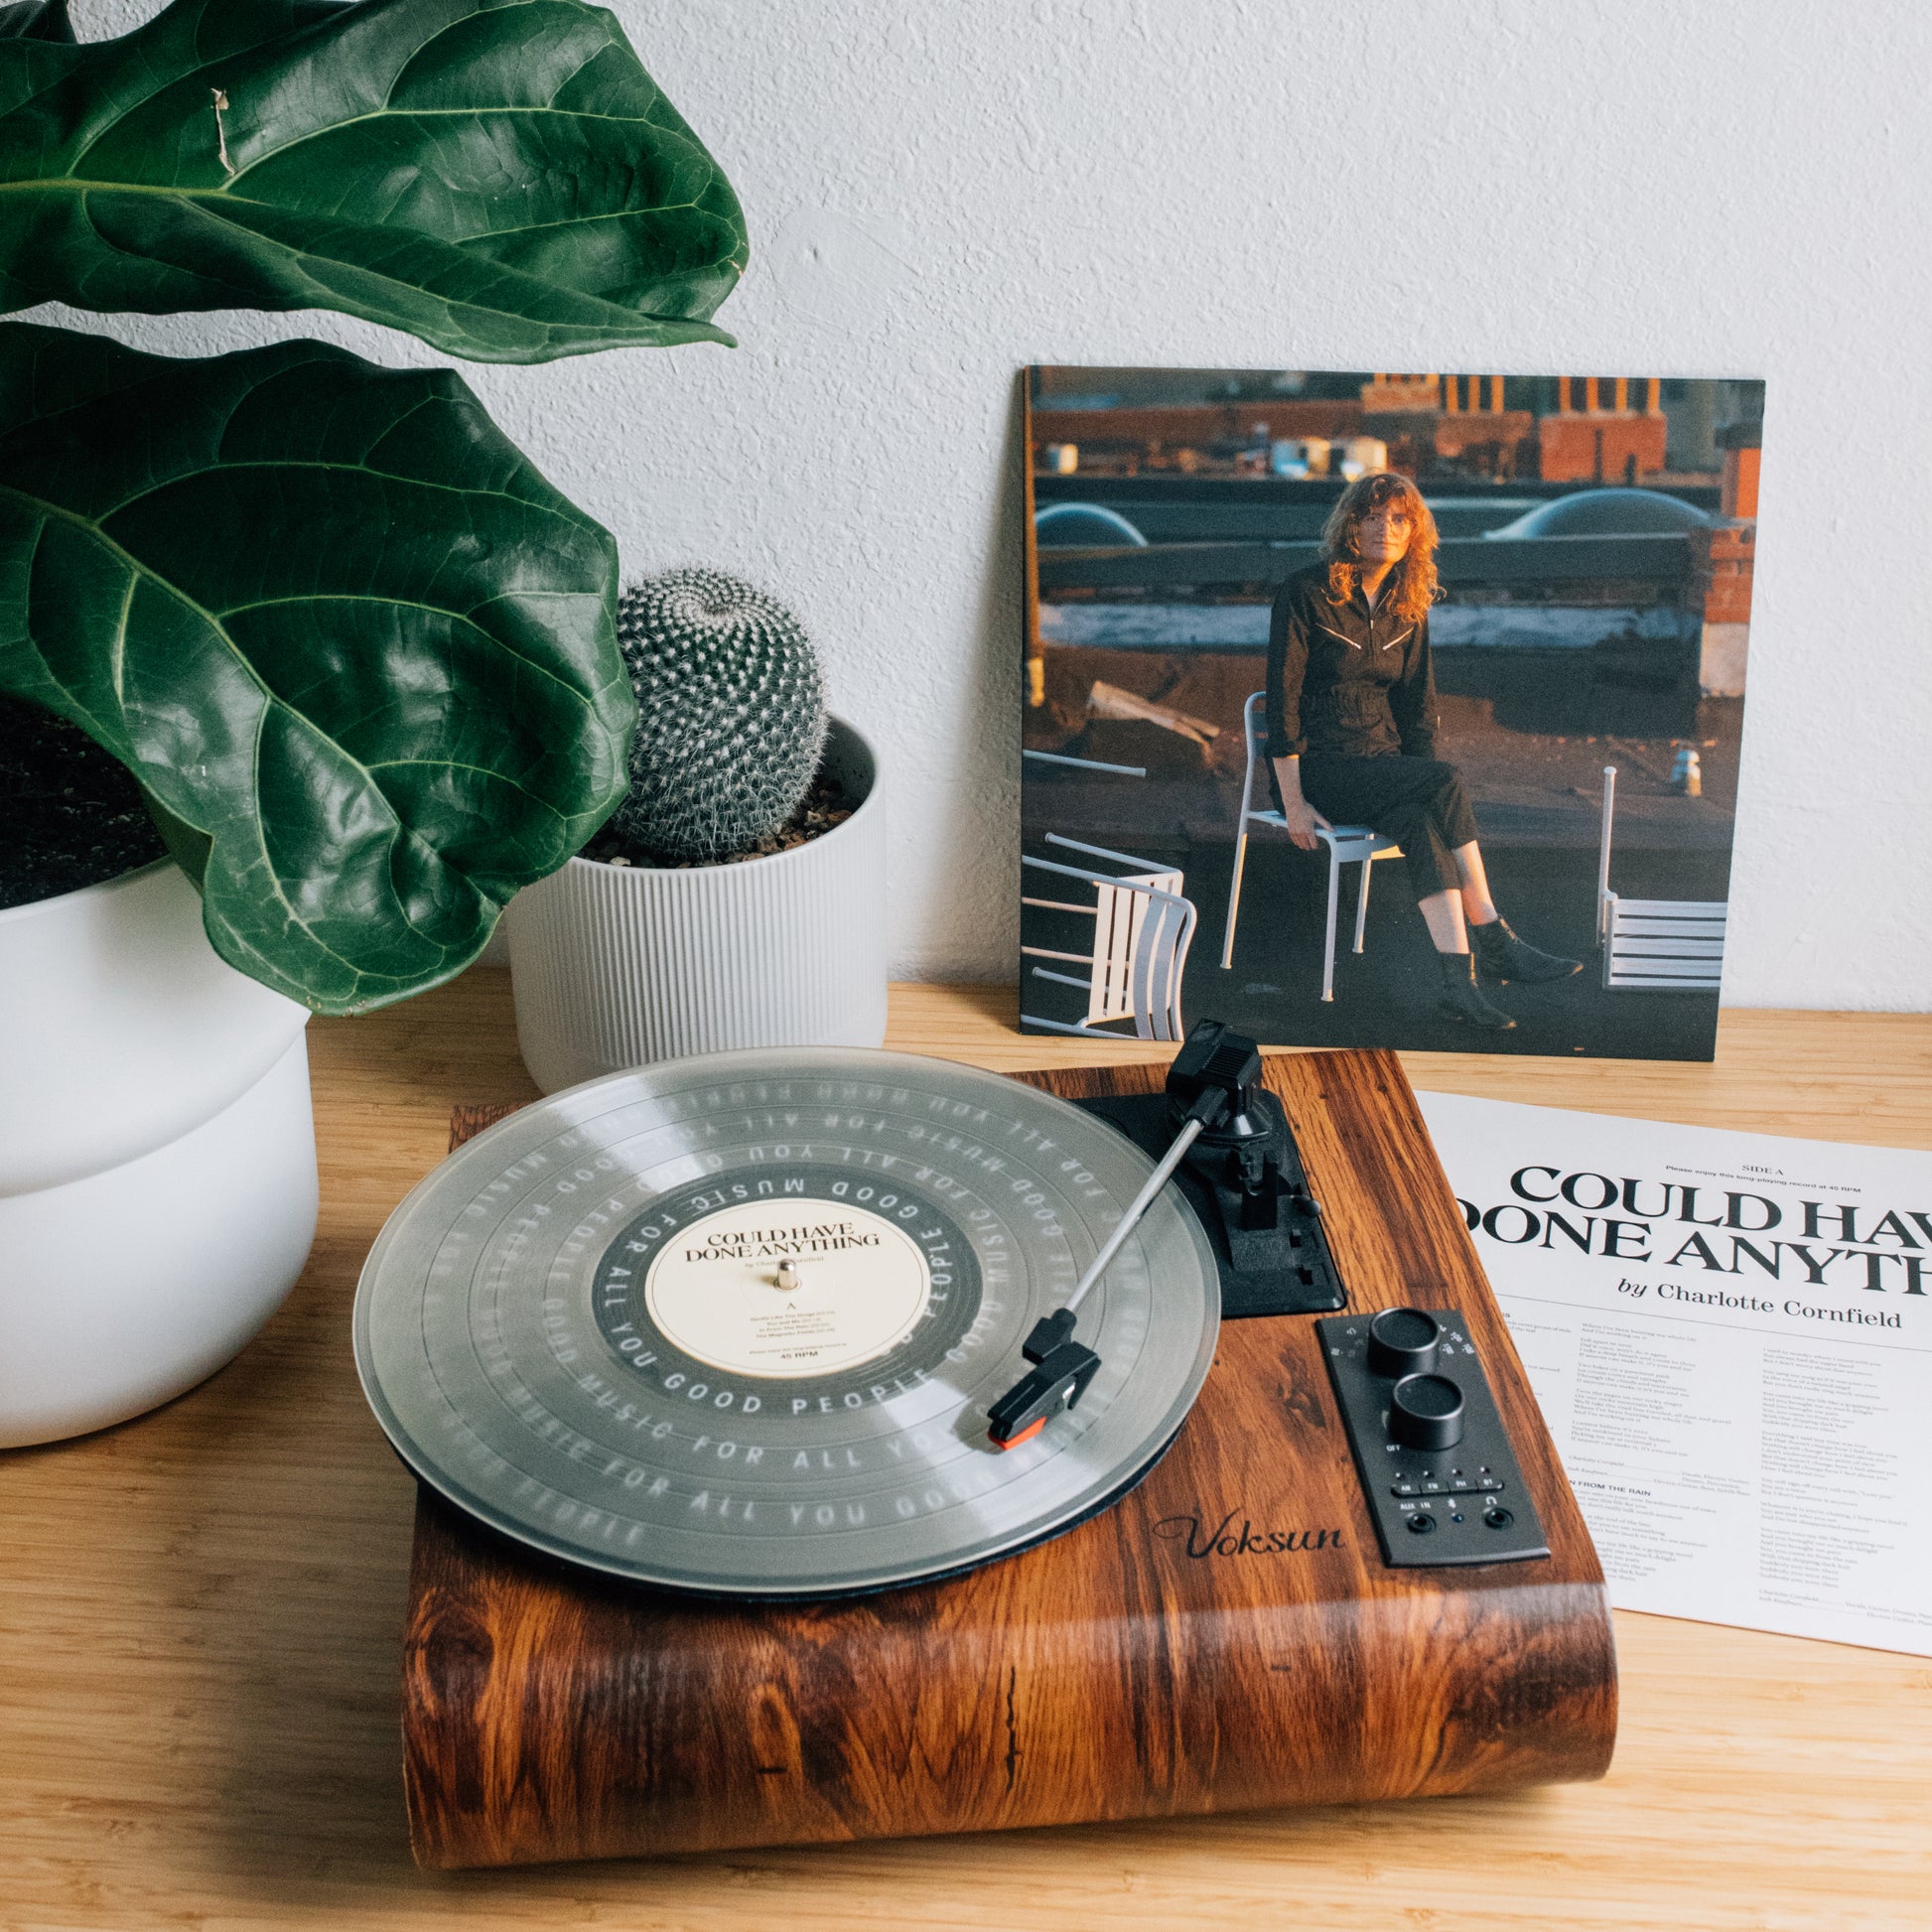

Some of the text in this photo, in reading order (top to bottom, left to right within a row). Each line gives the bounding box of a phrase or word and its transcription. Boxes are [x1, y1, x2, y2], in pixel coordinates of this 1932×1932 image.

[1666, 1165, 1693, 1173] Please
[1789, 1180, 1817, 1189] record
[1741, 1165, 1772, 1174] SIDE
[685, 1178, 804, 1210] MUSIC
[829, 1181, 924, 1220] GOOD
[1510, 1166, 1782, 1232] COULD
[622, 1213, 678, 1253] FOR
[686, 1233, 881, 1262] DONE ANYTHING
[708, 1222, 855, 1247] COULD HAVE
[606, 1267, 632, 1308] ALL
[1617, 1278, 1903, 1329] by Charlotte Cornfield
[786, 1302, 796, 1311] A
[610, 1321, 658, 1369] YOU
[659, 1371, 762, 1413] GOOD
[791, 1367, 930, 1414] PEOPLE
[692, 1435, 763, 1465] FOR
[793, 1448, 870, 1469] ALL
[1579, 1480, 1605, 1489] FROM
[1608, 1484, 1626, 1493] THE
[691, 1489, 759, 1522] ALL
[1153, 1507, 1345, 1559] Voksun
